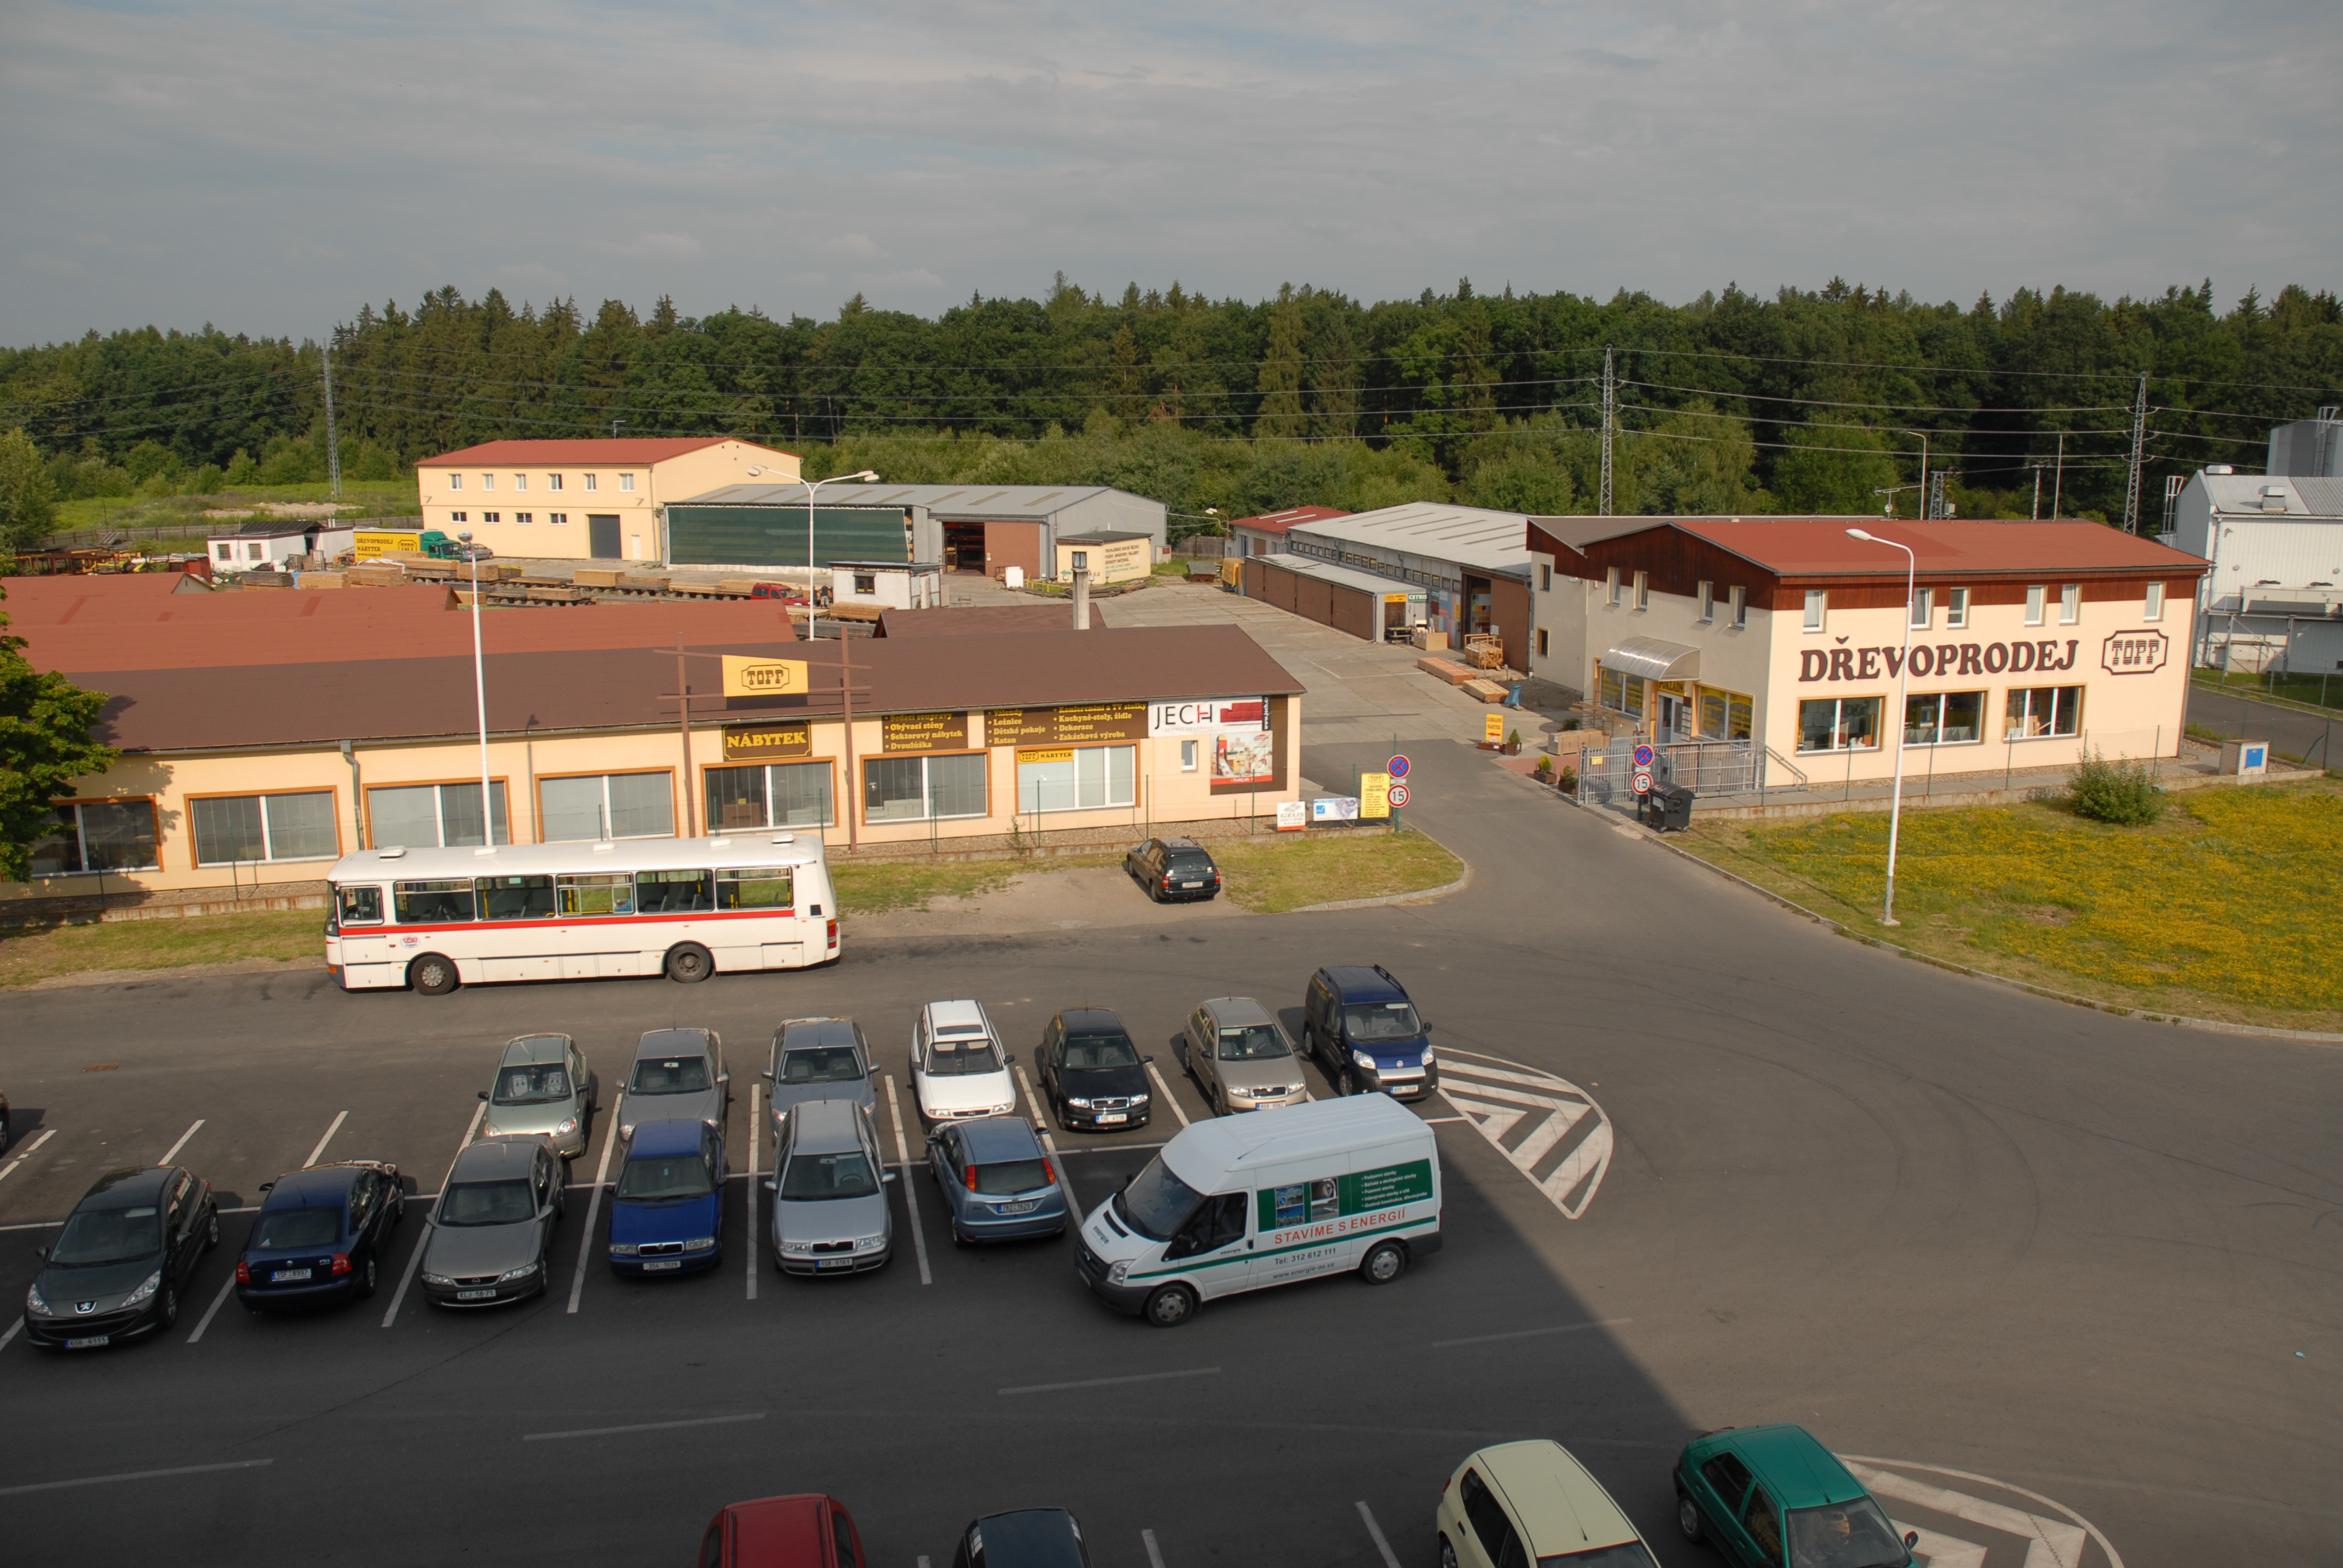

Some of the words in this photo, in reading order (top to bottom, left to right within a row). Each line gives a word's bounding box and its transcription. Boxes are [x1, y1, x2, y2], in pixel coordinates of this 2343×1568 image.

[1798, 636, 2080, 682] DŘEVOPRODEJ
[2111, 639, 2160, 666] TOPP
[747, 670, 784, 685] TOPP
[1155, 704, 1213, 730] JECH
[890, 722, 922, 731] Obývací
[1020, 726, 1046, 735] pokoje
[726, 731, 807, 748] NÁBYTEK
[890, 731, 930, 740] Sektorový
[932, 730, 963, 739] nábytek
[1059, 732, 1098, 740] Zakázková
[1099, 731, 1126, 739] výroba
[1637, 779, 1648, 789] 15
[1392, 791, 1404, 802] 15
[1274, 1224, 1334, 1244] STAVÍME
[1339, 1221, 1346, 1232] S
[1351, 1207, 1406, 1229] ENERGIÍ
[1092, 1226, 1110, 1244] energie
[1291, 1253, 1305, 1262] 312
[1308, 1250, 1322, 1259] 612
[1273, 1263, 1335, 1279] www.energie-as.cz
